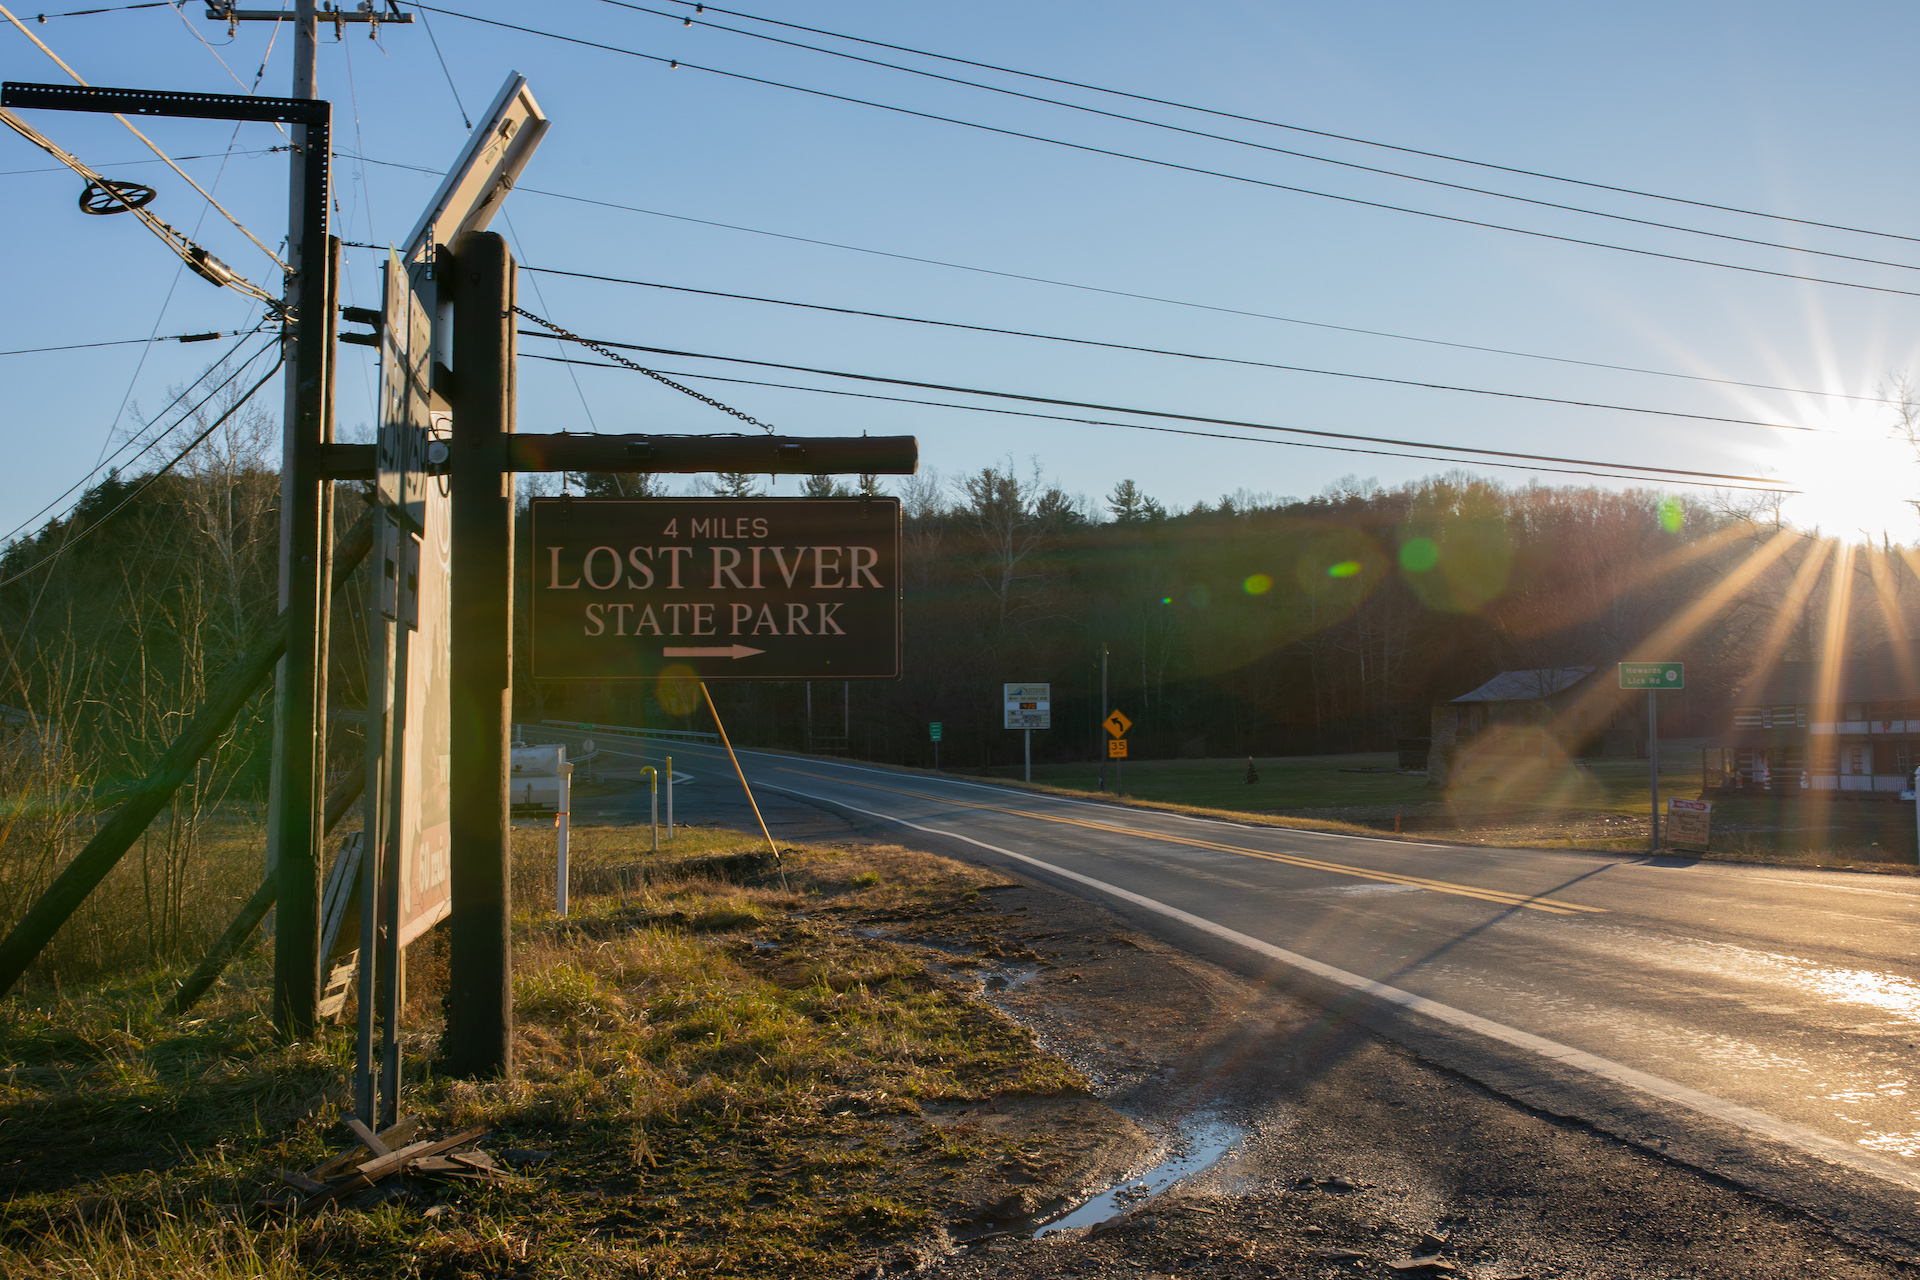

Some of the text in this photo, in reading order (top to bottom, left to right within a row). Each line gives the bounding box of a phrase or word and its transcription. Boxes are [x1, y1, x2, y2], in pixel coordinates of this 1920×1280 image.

[381, 371, 402, 472] 259
[406, 408, 427, 499] 259
[663, 517, 769, 539] 4 MILES
[546, 545, 884, 590] LOST RIVER
[584, 602, 847, 636] STATE PARK
[1111, 742, 1126, 750] 35
[418, 840, 430, 894] 60
